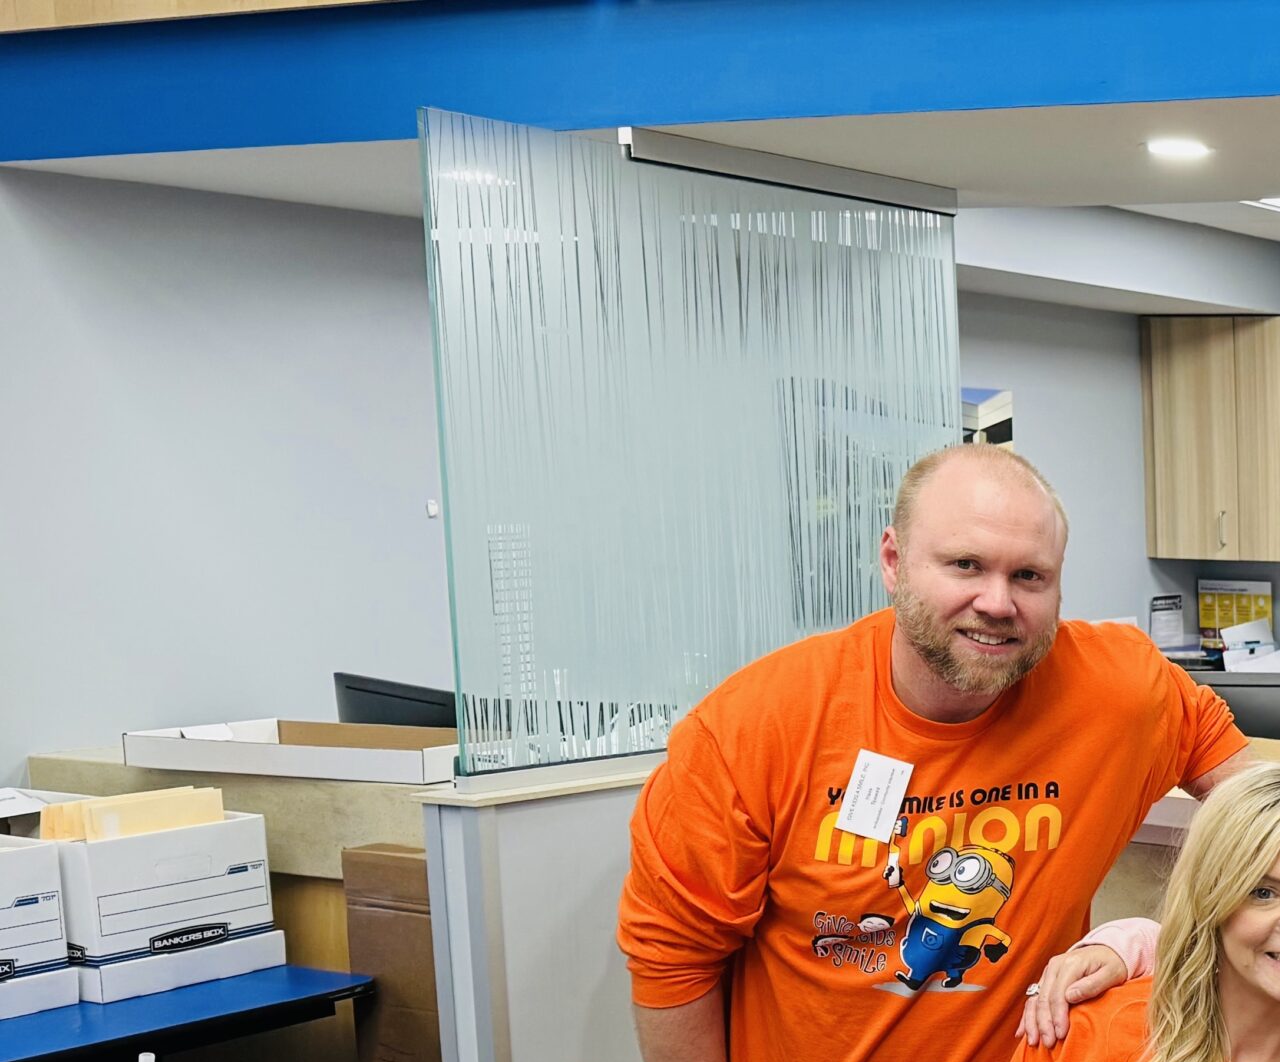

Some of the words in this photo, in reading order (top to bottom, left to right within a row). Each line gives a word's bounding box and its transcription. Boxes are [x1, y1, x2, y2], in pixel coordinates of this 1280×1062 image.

[900, 796, 946, 814] MILE
[949, 789, 964, 808] IS
[970, 784, 1012, 806] ONE
[1017, 782, 1039, 800] IN
[1046, 781, 1059, 798] A
[154, 931, 202, 949] BANKERS
[202, 927, 225, 939] BOX
[68, 949, 83, 959] OX
